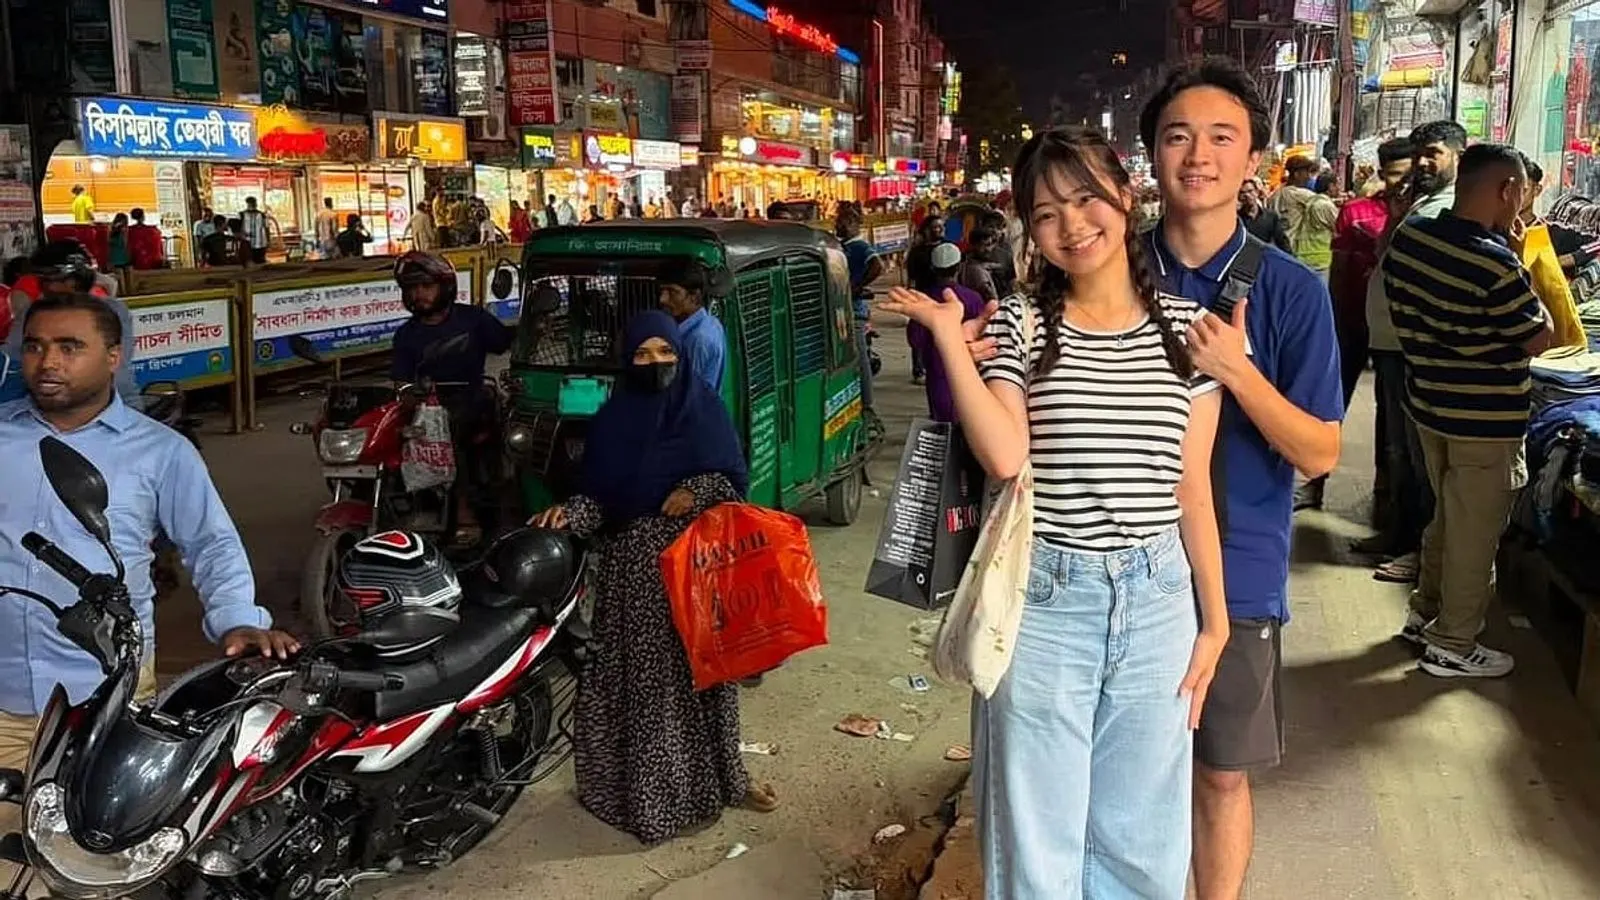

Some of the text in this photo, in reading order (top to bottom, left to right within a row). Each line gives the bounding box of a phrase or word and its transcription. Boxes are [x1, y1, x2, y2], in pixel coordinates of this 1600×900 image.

[174, 110, 225, 151] তেহারী
[228, 121, 251, 148] ঘর
[138, 307, 205, 324] কাজ চলমান
[302, 305, 335, 324] নির্মাণ
[340, 304, 361, 317] কাজ
[132, 323, 223, 351] লাচল সীমিত
